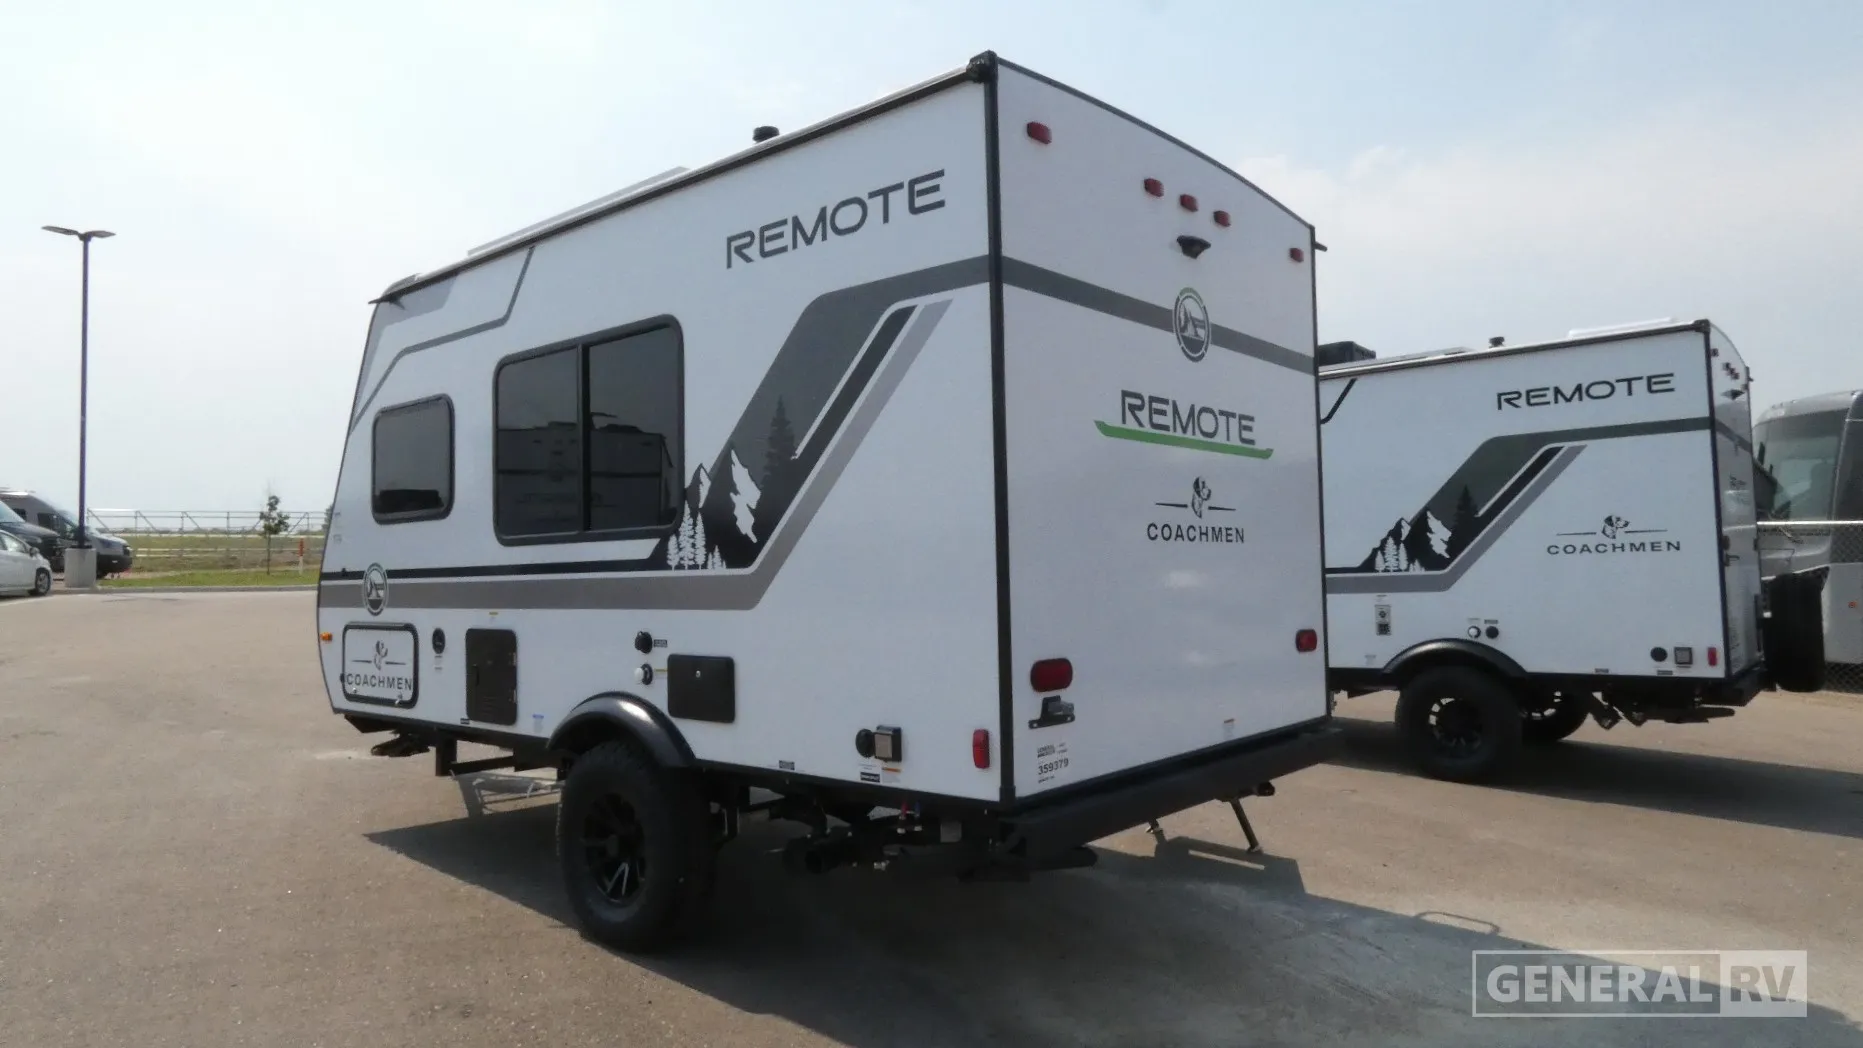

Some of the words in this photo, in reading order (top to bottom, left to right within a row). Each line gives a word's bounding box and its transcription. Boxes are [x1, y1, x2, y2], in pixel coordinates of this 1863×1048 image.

[726, 168, 946, 270] REMOTE
[1496, 372, 1676, 411] REMOTE
[1120, 389, 1256, 446] REMOTE
[1146, 522, 1245, 544] COACHMEN
[1546, 540, 1681, 555] COACHMEN
[346, 672, 412, 691] COACHMEN
[1038, 757, 1069, 775] 359379
